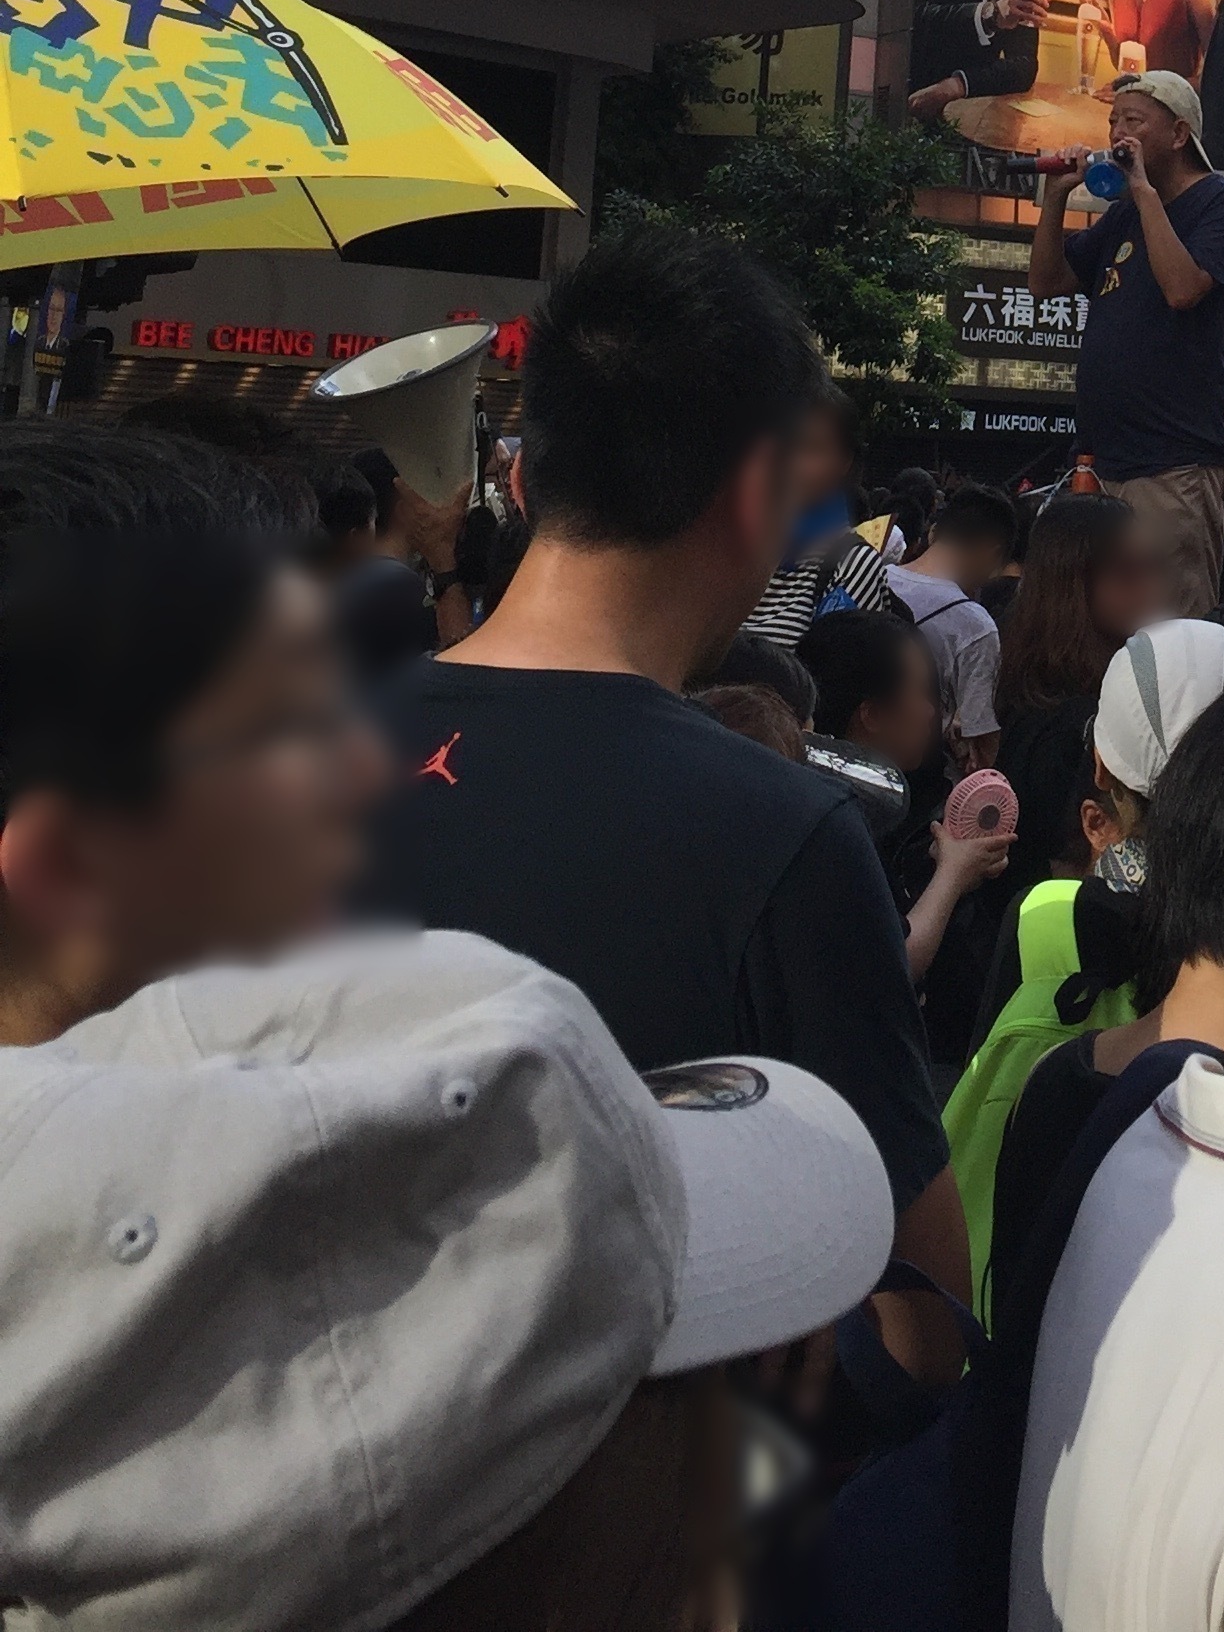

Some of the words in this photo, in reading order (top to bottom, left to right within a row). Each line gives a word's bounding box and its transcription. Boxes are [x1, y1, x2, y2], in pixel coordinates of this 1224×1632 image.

[134, 320, 194, 349] BEE
[212, 324, 316, 358] CHENG
[333, 333, 392, 360] HIA
[962, 326, 1024, 345] LUKFOOK
[985, 413, 1047, 433] LUKFOOK
